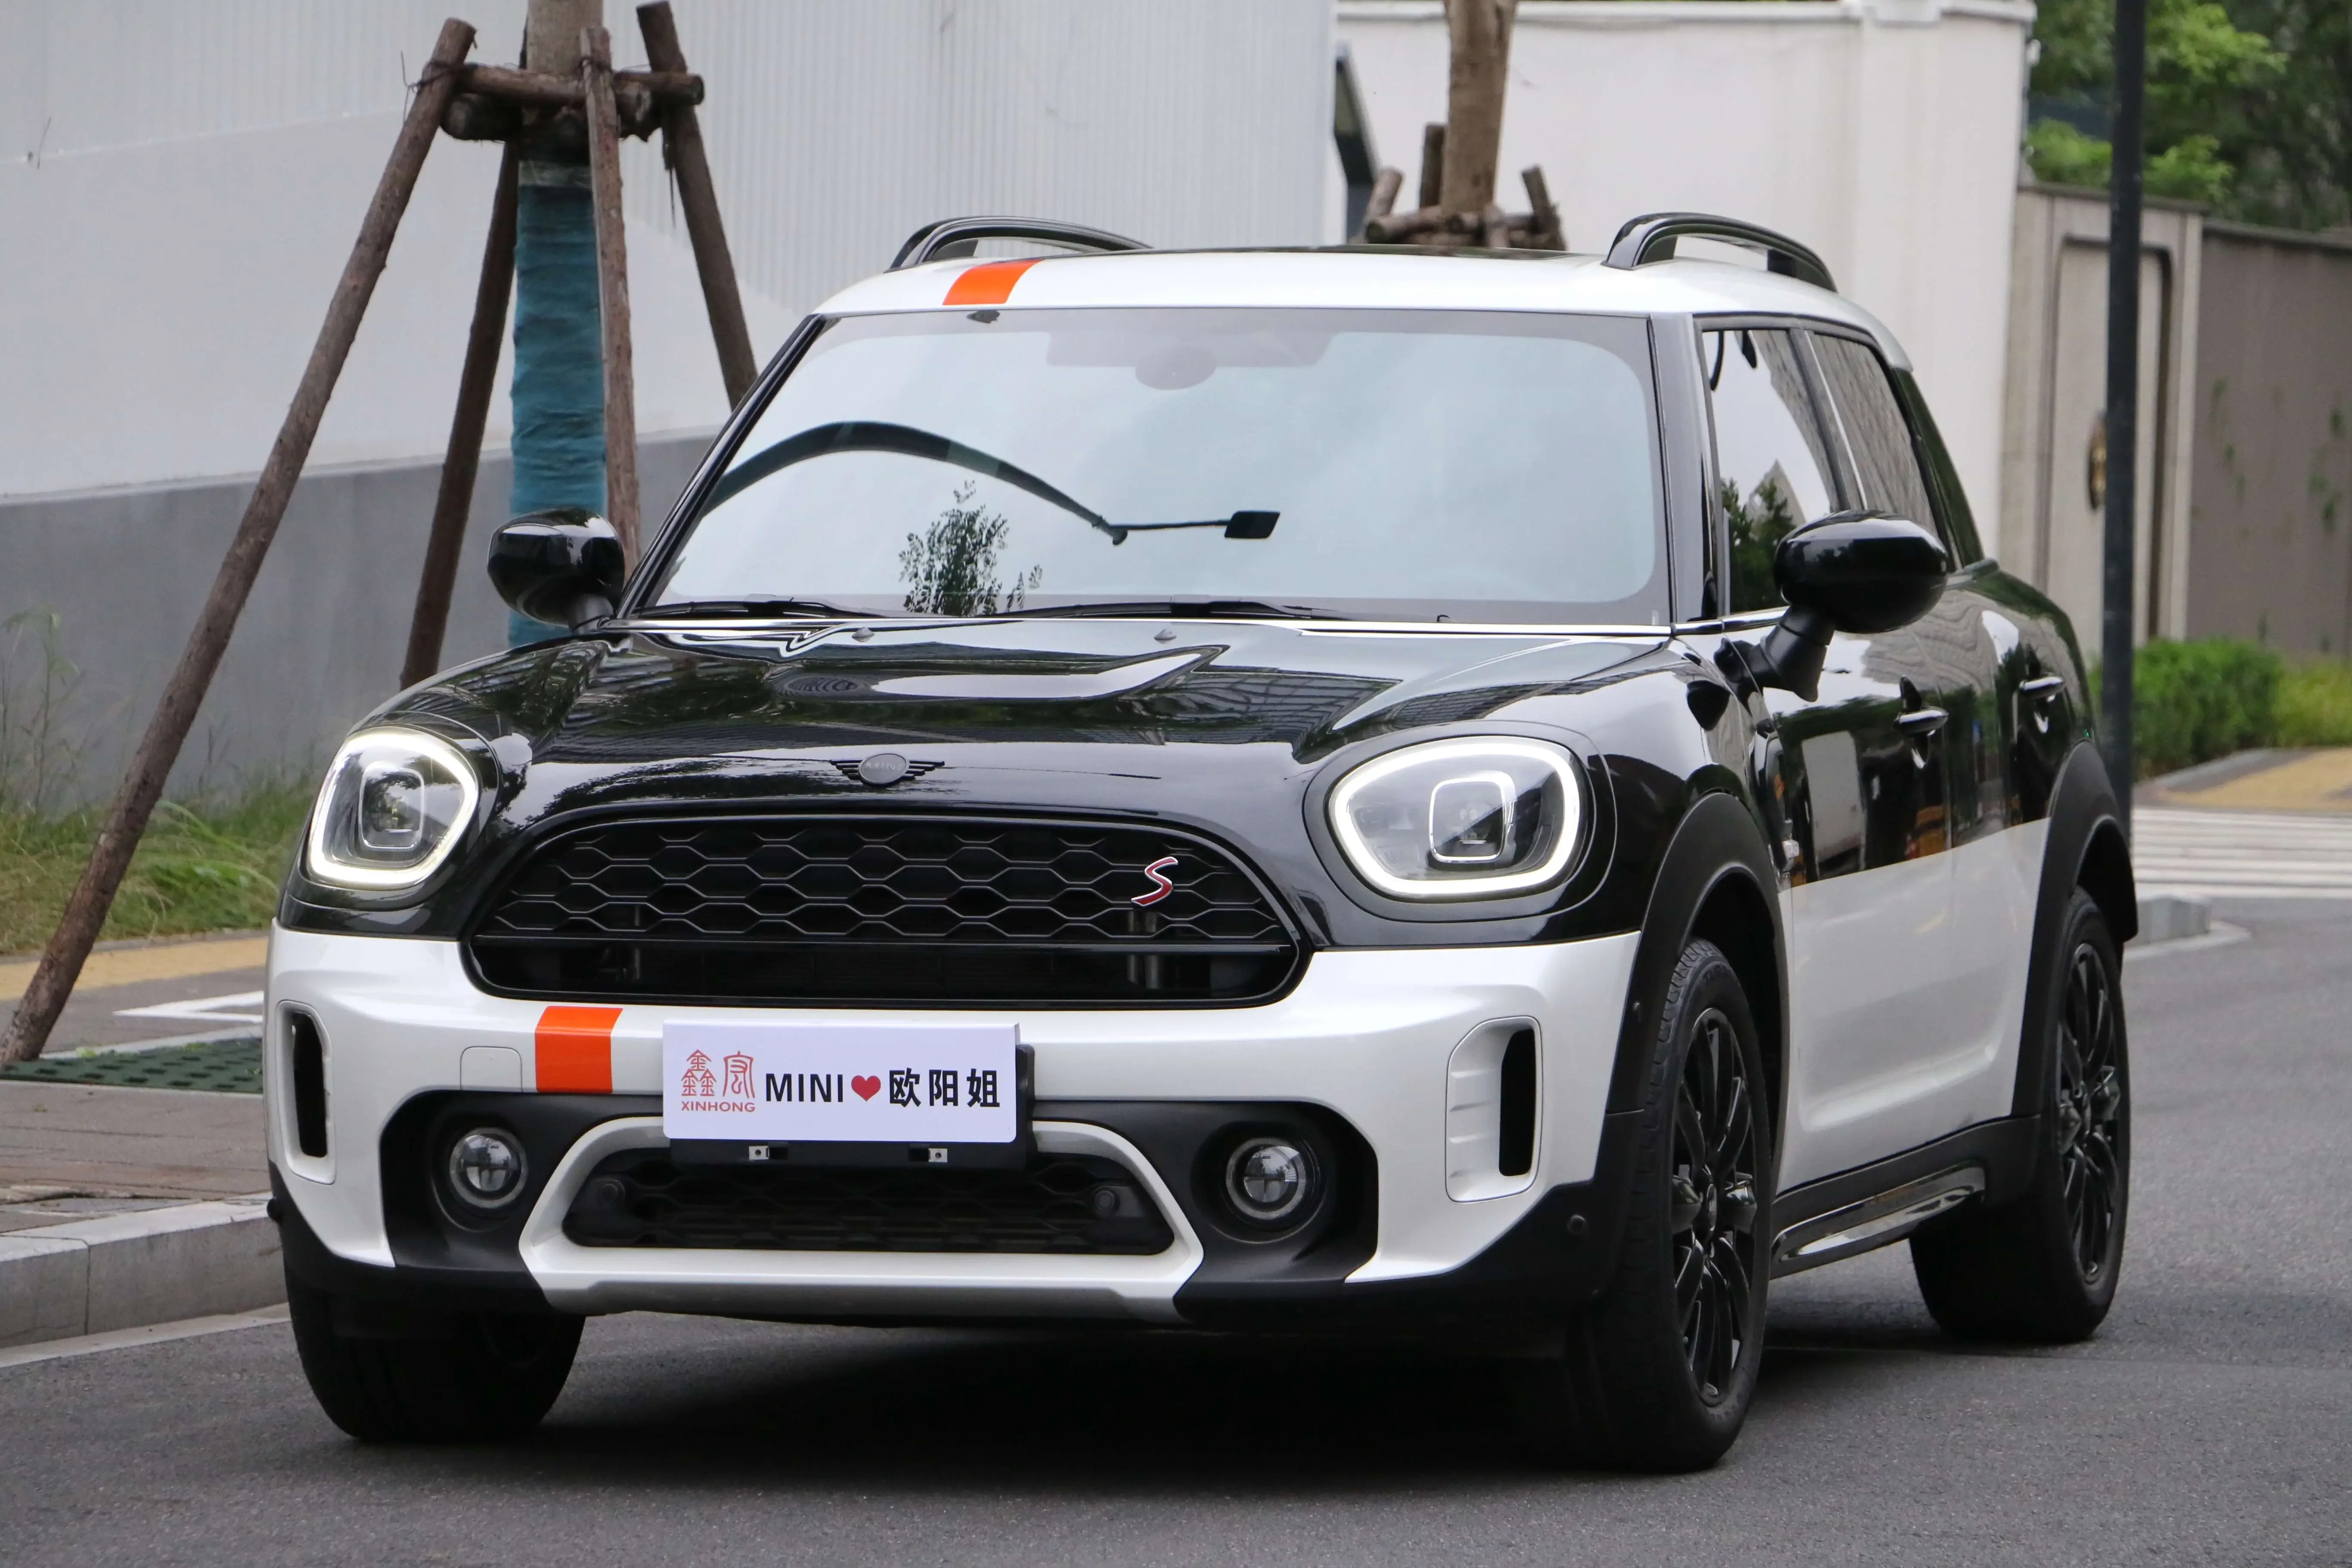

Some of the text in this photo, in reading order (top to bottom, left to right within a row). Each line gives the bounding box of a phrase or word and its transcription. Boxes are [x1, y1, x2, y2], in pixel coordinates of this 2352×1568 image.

[1131, 856, 1179, 906] S
[681, 1100, 756, 1112] XINHONG
[766, 1067, 1001, 1108] MINI 欧阳姐
